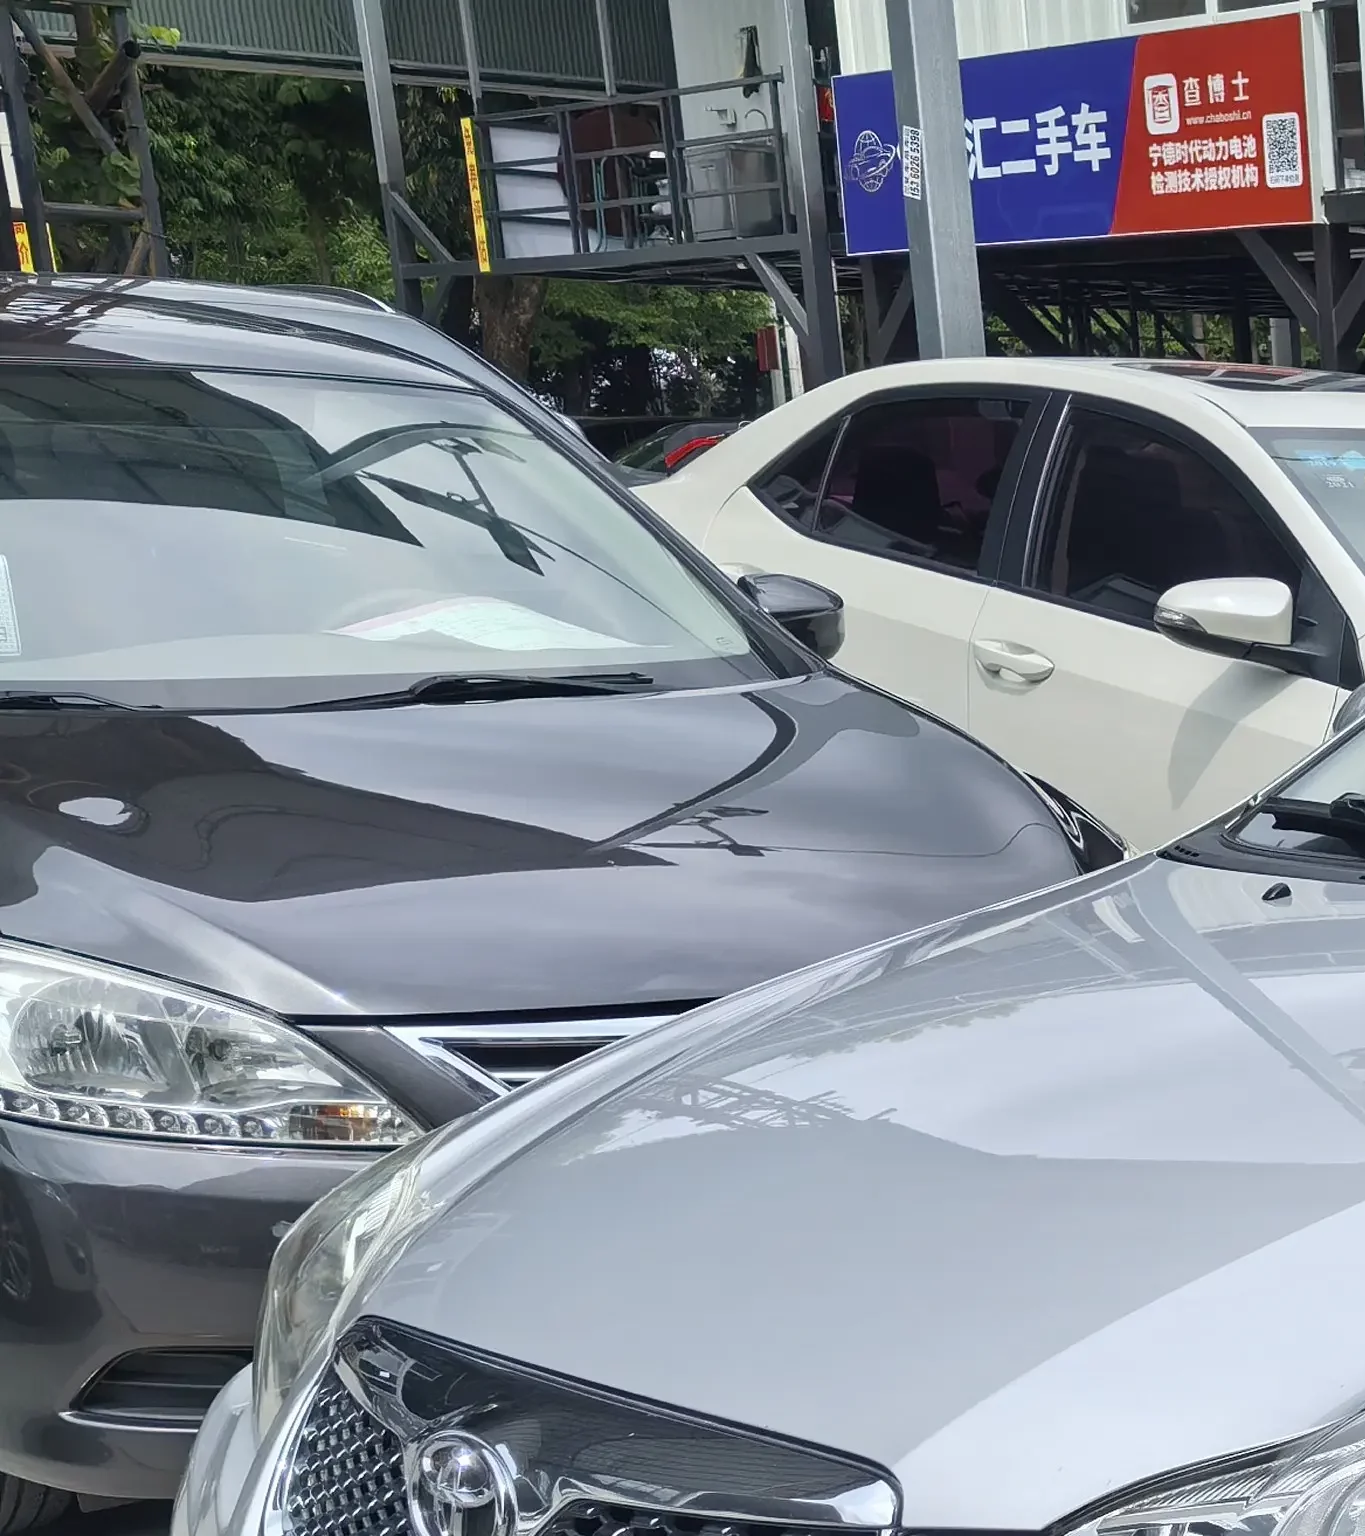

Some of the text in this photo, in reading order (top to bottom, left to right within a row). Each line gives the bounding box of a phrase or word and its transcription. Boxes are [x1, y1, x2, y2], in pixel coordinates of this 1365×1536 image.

[1183, 70, 1250, 106] 查博士
[1185, 110, 1252, 126] www.chaboshi.cn
[1149, 134, 1257, 167] 宁德时代动力电池
[1151, 164, 1259, 195] 检测技术授权机构
